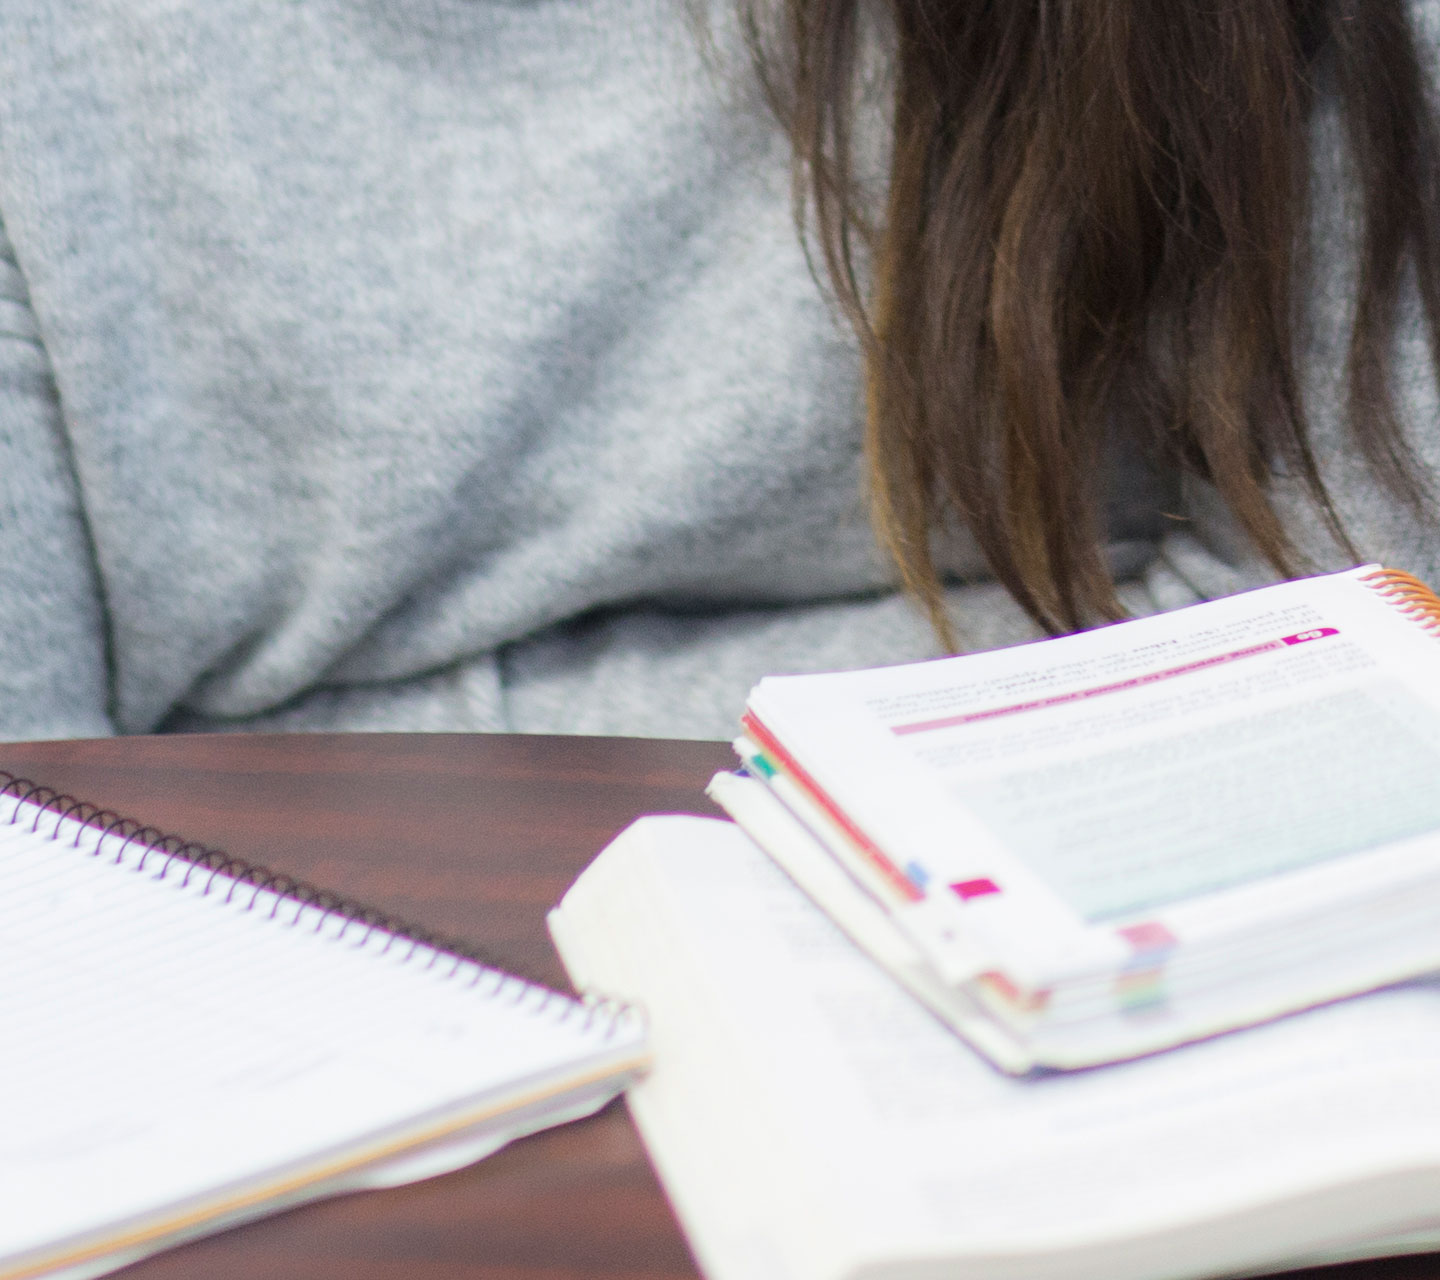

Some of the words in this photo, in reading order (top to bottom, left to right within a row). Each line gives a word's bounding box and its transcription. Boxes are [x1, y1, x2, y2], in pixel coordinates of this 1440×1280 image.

[1228, 641, 1277, 659] Using
[1163, 655, 1226, 677] appeals
[1081, 677, 1138, 697] ground
[1141, 673, 1160, 682] to
[1042, 691, 1078, 705] your
[962, 700, 1039, 722] argument
